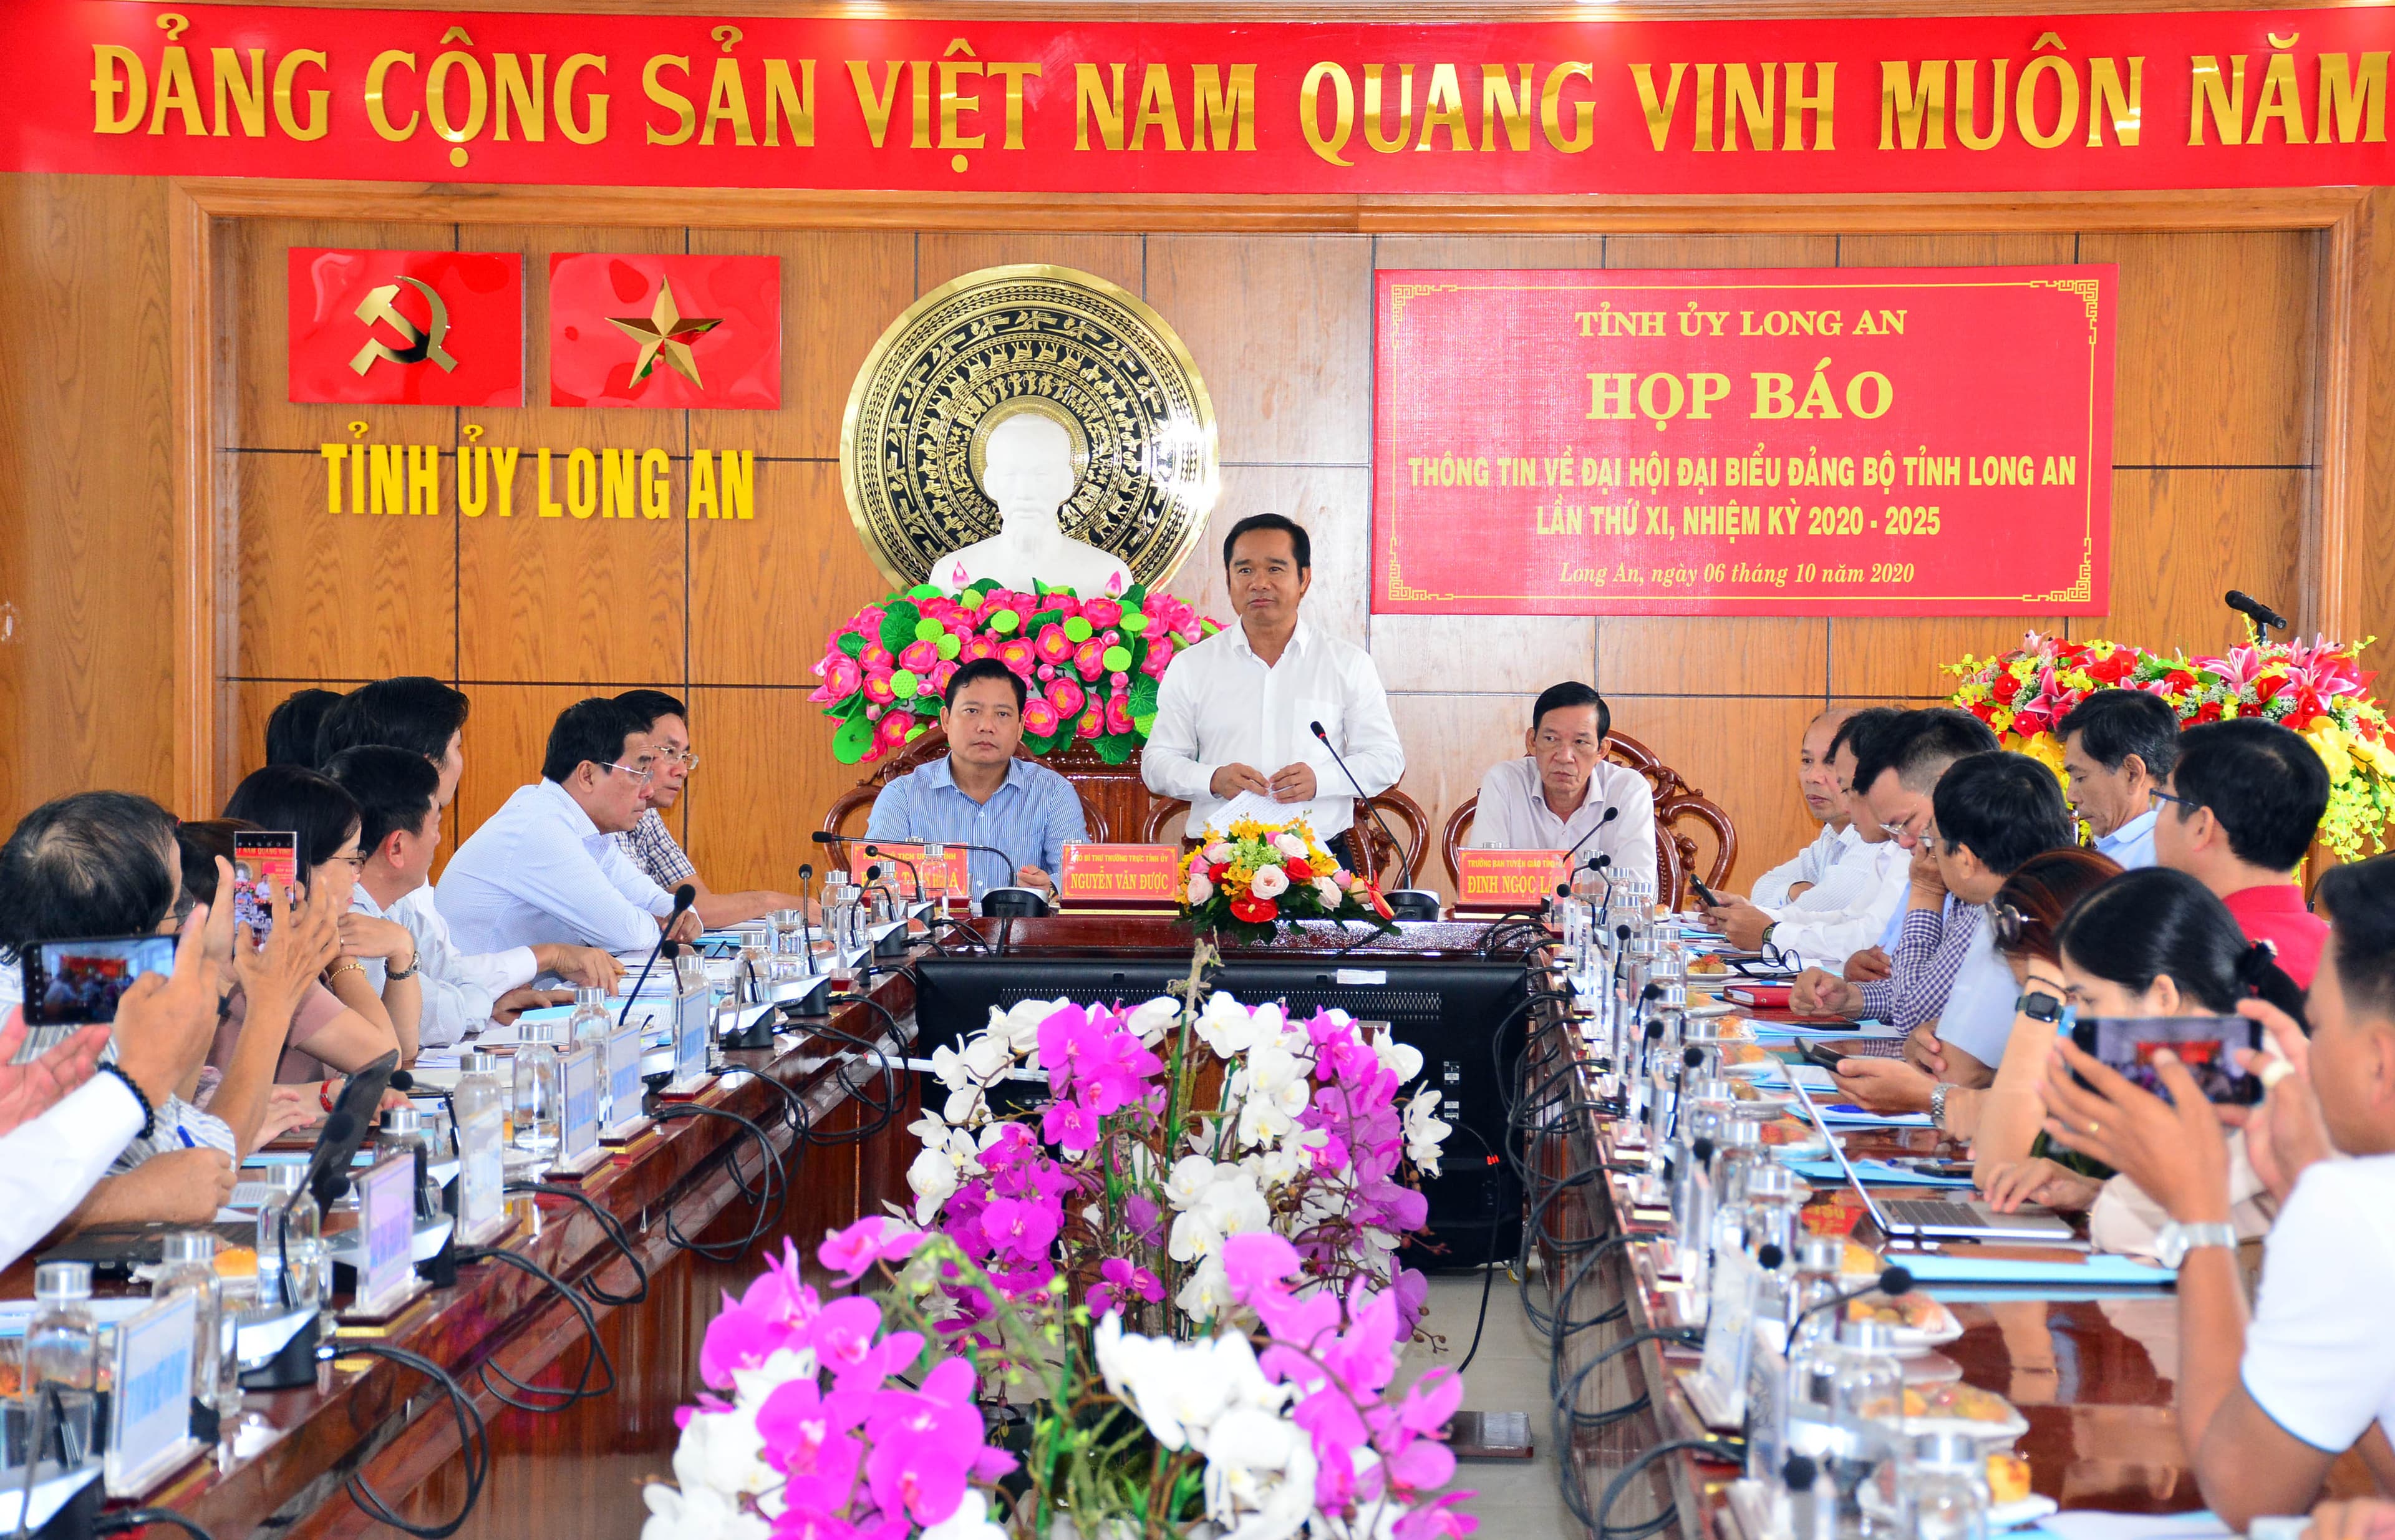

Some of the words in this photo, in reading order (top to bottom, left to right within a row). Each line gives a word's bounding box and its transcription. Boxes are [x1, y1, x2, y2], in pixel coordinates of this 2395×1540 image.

[91, 14, 329, 141] ĐẢNG
[365, 27, 609, 167] CỘNG
[643, 26, 815, 147] SẢN
[846, 39, 1042, 172] VIỆT
[1075, 64, 1257, 151] NAM
[1300, 62, 1595, 167] QUANG
[1630, 62, 1837, 151] VINH
[1879, 32, 2145, 150] MUÔN
[2189, 33, 2390, 145] NĂM
[1575, 303, 1666, 336] TỈNH
[1678, 302, 1729, 336] ỦY
[1740, 311, 1842, 336] LONG
[1853, 310, 1907, 334] AN
[1587, 373, 1730, 431] HỌP
[1751, 357, 1893, 419] BÁO
[321, 419, 440, 516] TỈNH
[457, 423, 520, 519] ỦY
[536, 443, 671, 521] LONG
[687, 444, 756, 523] AN
[1410, 452, 1488, 485] THÔNG
[1499, 458, 1535, 485] TIN
[1545, 444, 1574, 485] VỀ
[1582, 458, 1620, 495] ĐẠI
[1630, 452, 1669, 494] HỘI
[1677, 457, 1717, 495] ĐẠI
[1726, 443, 1780, 487] BIỂU
[1788, 447, 1854, 486] ĐẢNG
[1864, 450, 1895, 494] BỘ
[1904, 446, 1960, 485] TỈNH
[1969, 456, 2033, 486] LONG
[2042, 457, 2076, 485] AN
[1537, 493, 1582, 535] LẦN
[1590, 498, 1640, 535] THỨ
[1647, 507, 1674, 540] XI,
[1684, 500, 1759, 543] NHIỆM
[1769, 498, 1800, 534] KỲ
[1809, 507, 1863, 535] 2020
[1885, 506, 1940, 535] 2025
[1560, 563, 1607, 586] Long
[1613, 563, 1645, 585] An,
[1652, 566, 1697, 587] ngày
[1705, 563, 1726, 583] 06
[1731, 563, 1789, 587] tháng
[1794, 563, 1817, 583] 10
[1822, 564, 1864, 583] năm
[1870, 563, 1915, 583] 2020
[1070, 865, 1113, 889] NGUYỄN
[1115, 869, 1136, 889] VĂN
[1139, 871, 1168, 893] ĐƯỢC
[1467, 875, 1498, 894] ĐINH
[1502, 875, 1536, 898] NGỌC
